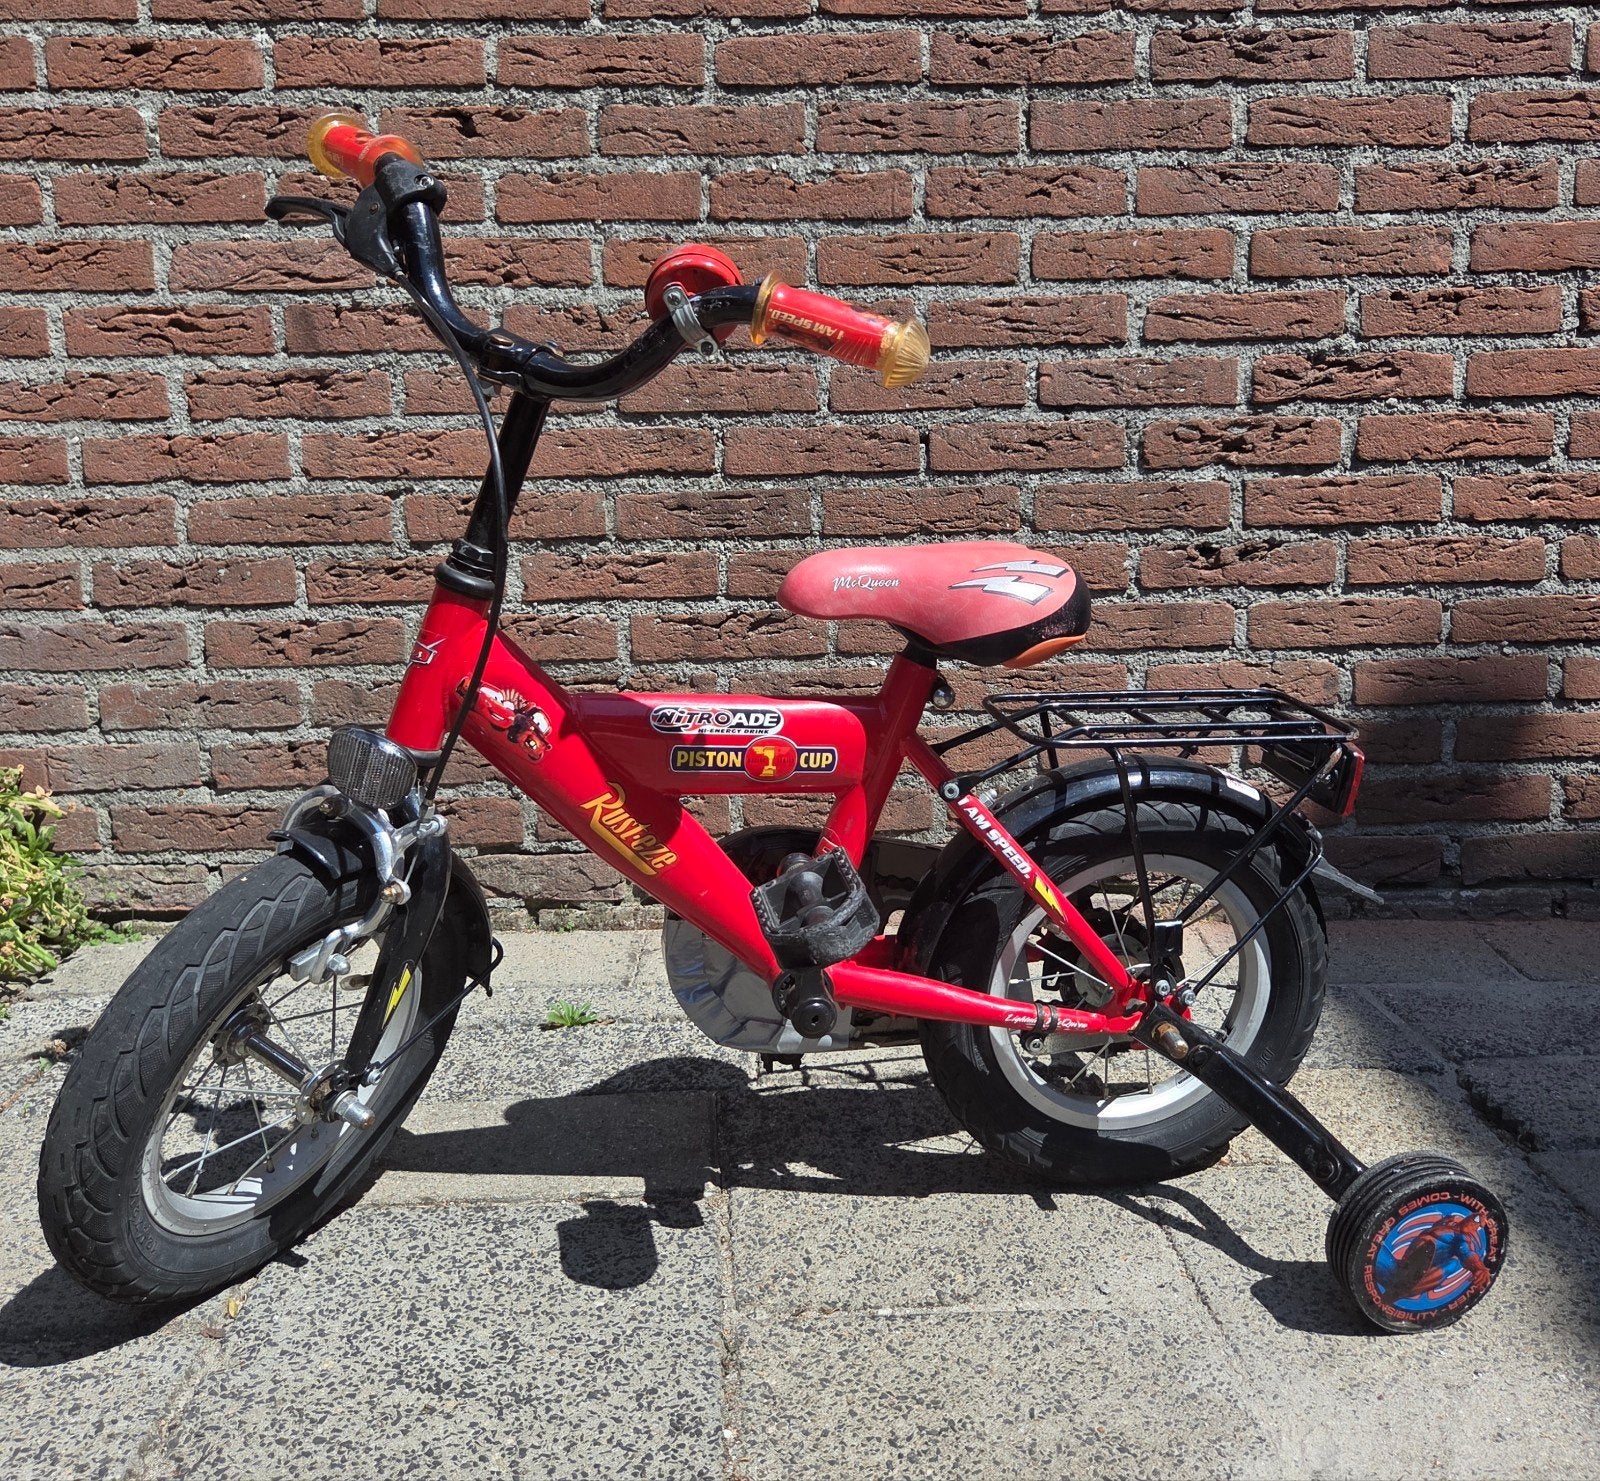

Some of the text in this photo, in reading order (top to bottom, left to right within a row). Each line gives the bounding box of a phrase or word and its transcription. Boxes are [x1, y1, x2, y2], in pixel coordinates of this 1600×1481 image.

[814, 323, 838, 337] AM
[832, 574, 901, 592] McQueen
[676, 750, 742, 767] PISTON
[799, 751, 833, 769] CUP
[963, 806, 992, 830] AM
[1363, 1191, 1451, 1322] COMES GREAT RESPONSIBILITY
[1448, 1193, 1500, 1311] WITH GREAT WER
